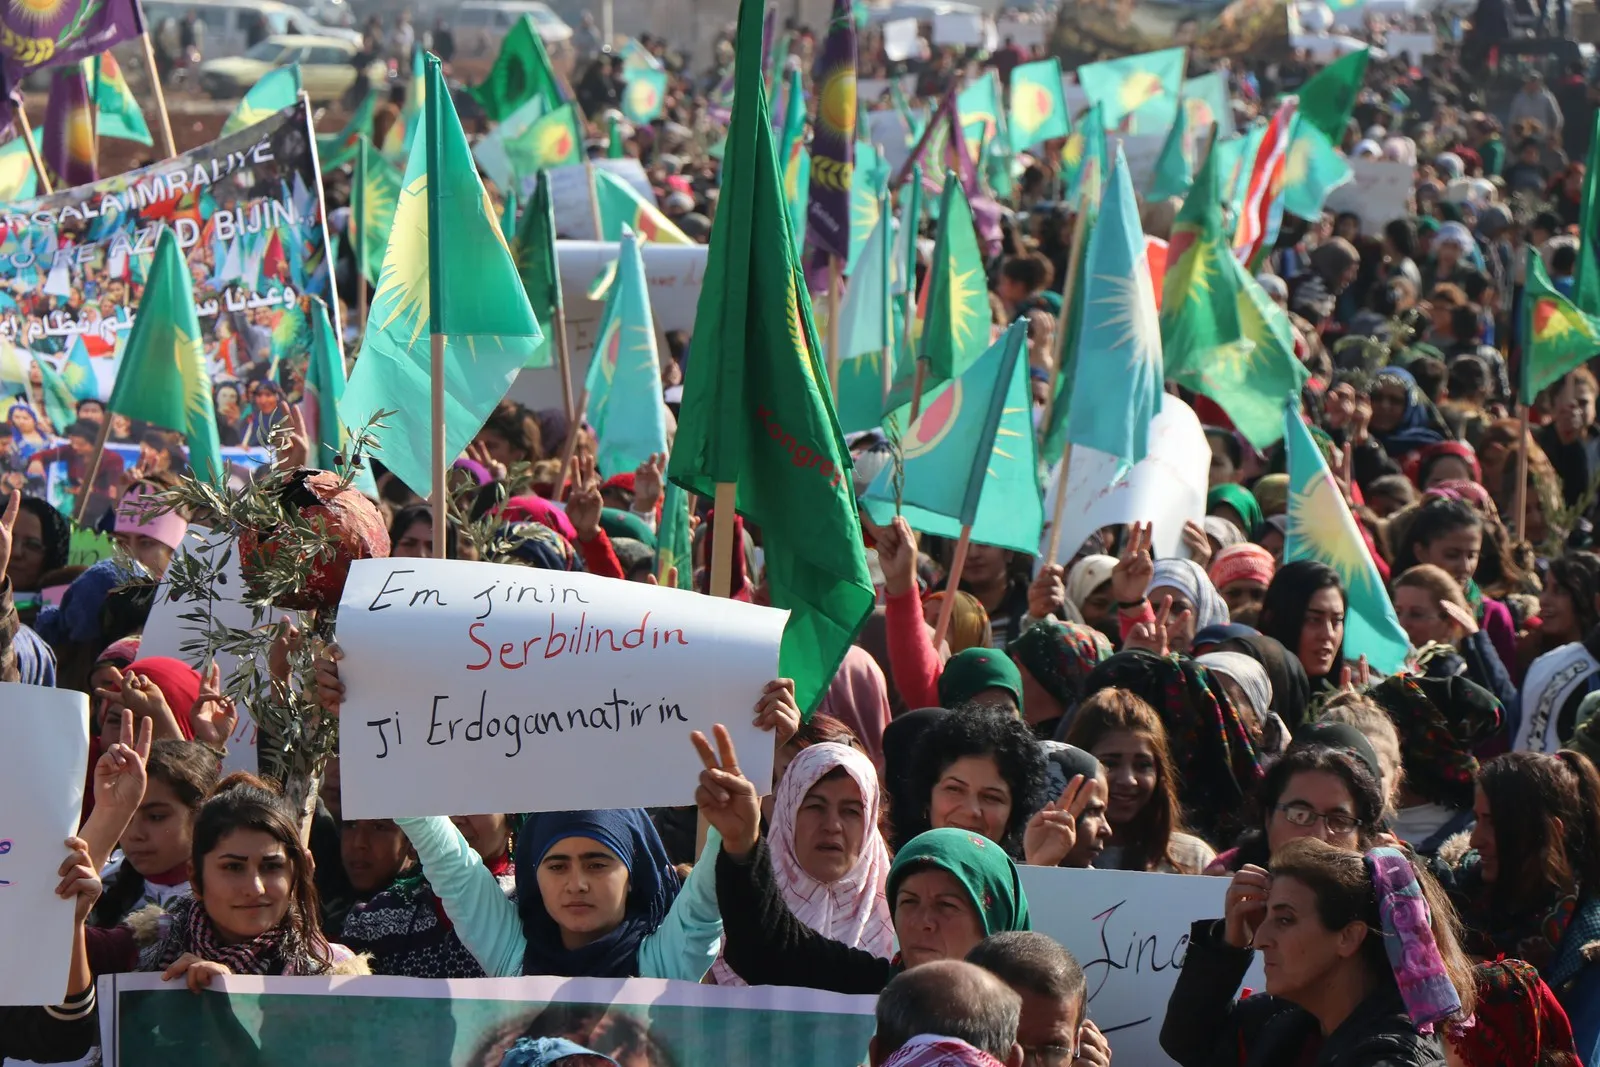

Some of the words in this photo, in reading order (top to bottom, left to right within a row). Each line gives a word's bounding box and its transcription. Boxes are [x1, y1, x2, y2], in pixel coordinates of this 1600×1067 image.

[225, 286, 297, 313] وعدنا
[368, 570, 448, 612] Em
[466, 611, 689, 671] Serbilindin
